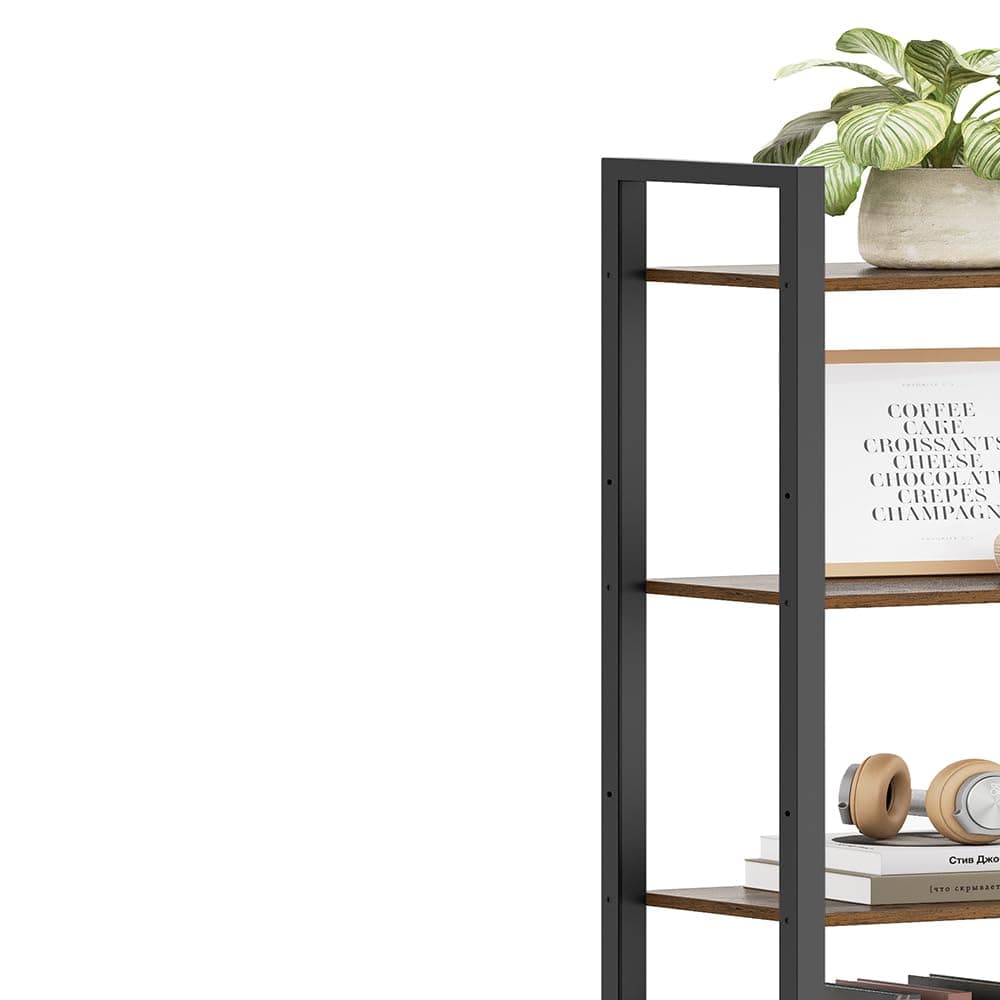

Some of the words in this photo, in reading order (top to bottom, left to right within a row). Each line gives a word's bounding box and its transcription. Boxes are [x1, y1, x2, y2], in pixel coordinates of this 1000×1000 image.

[887, 401, 976, 418] COFFEE
[903, 419, 965, 435] CAKE
[893, 453, 984, 470] CHEESE
[897, 487, 988, 504] CREPES
[948, 855, 975, 865] Стив
[954, 883, 1000, 893] скрывает
